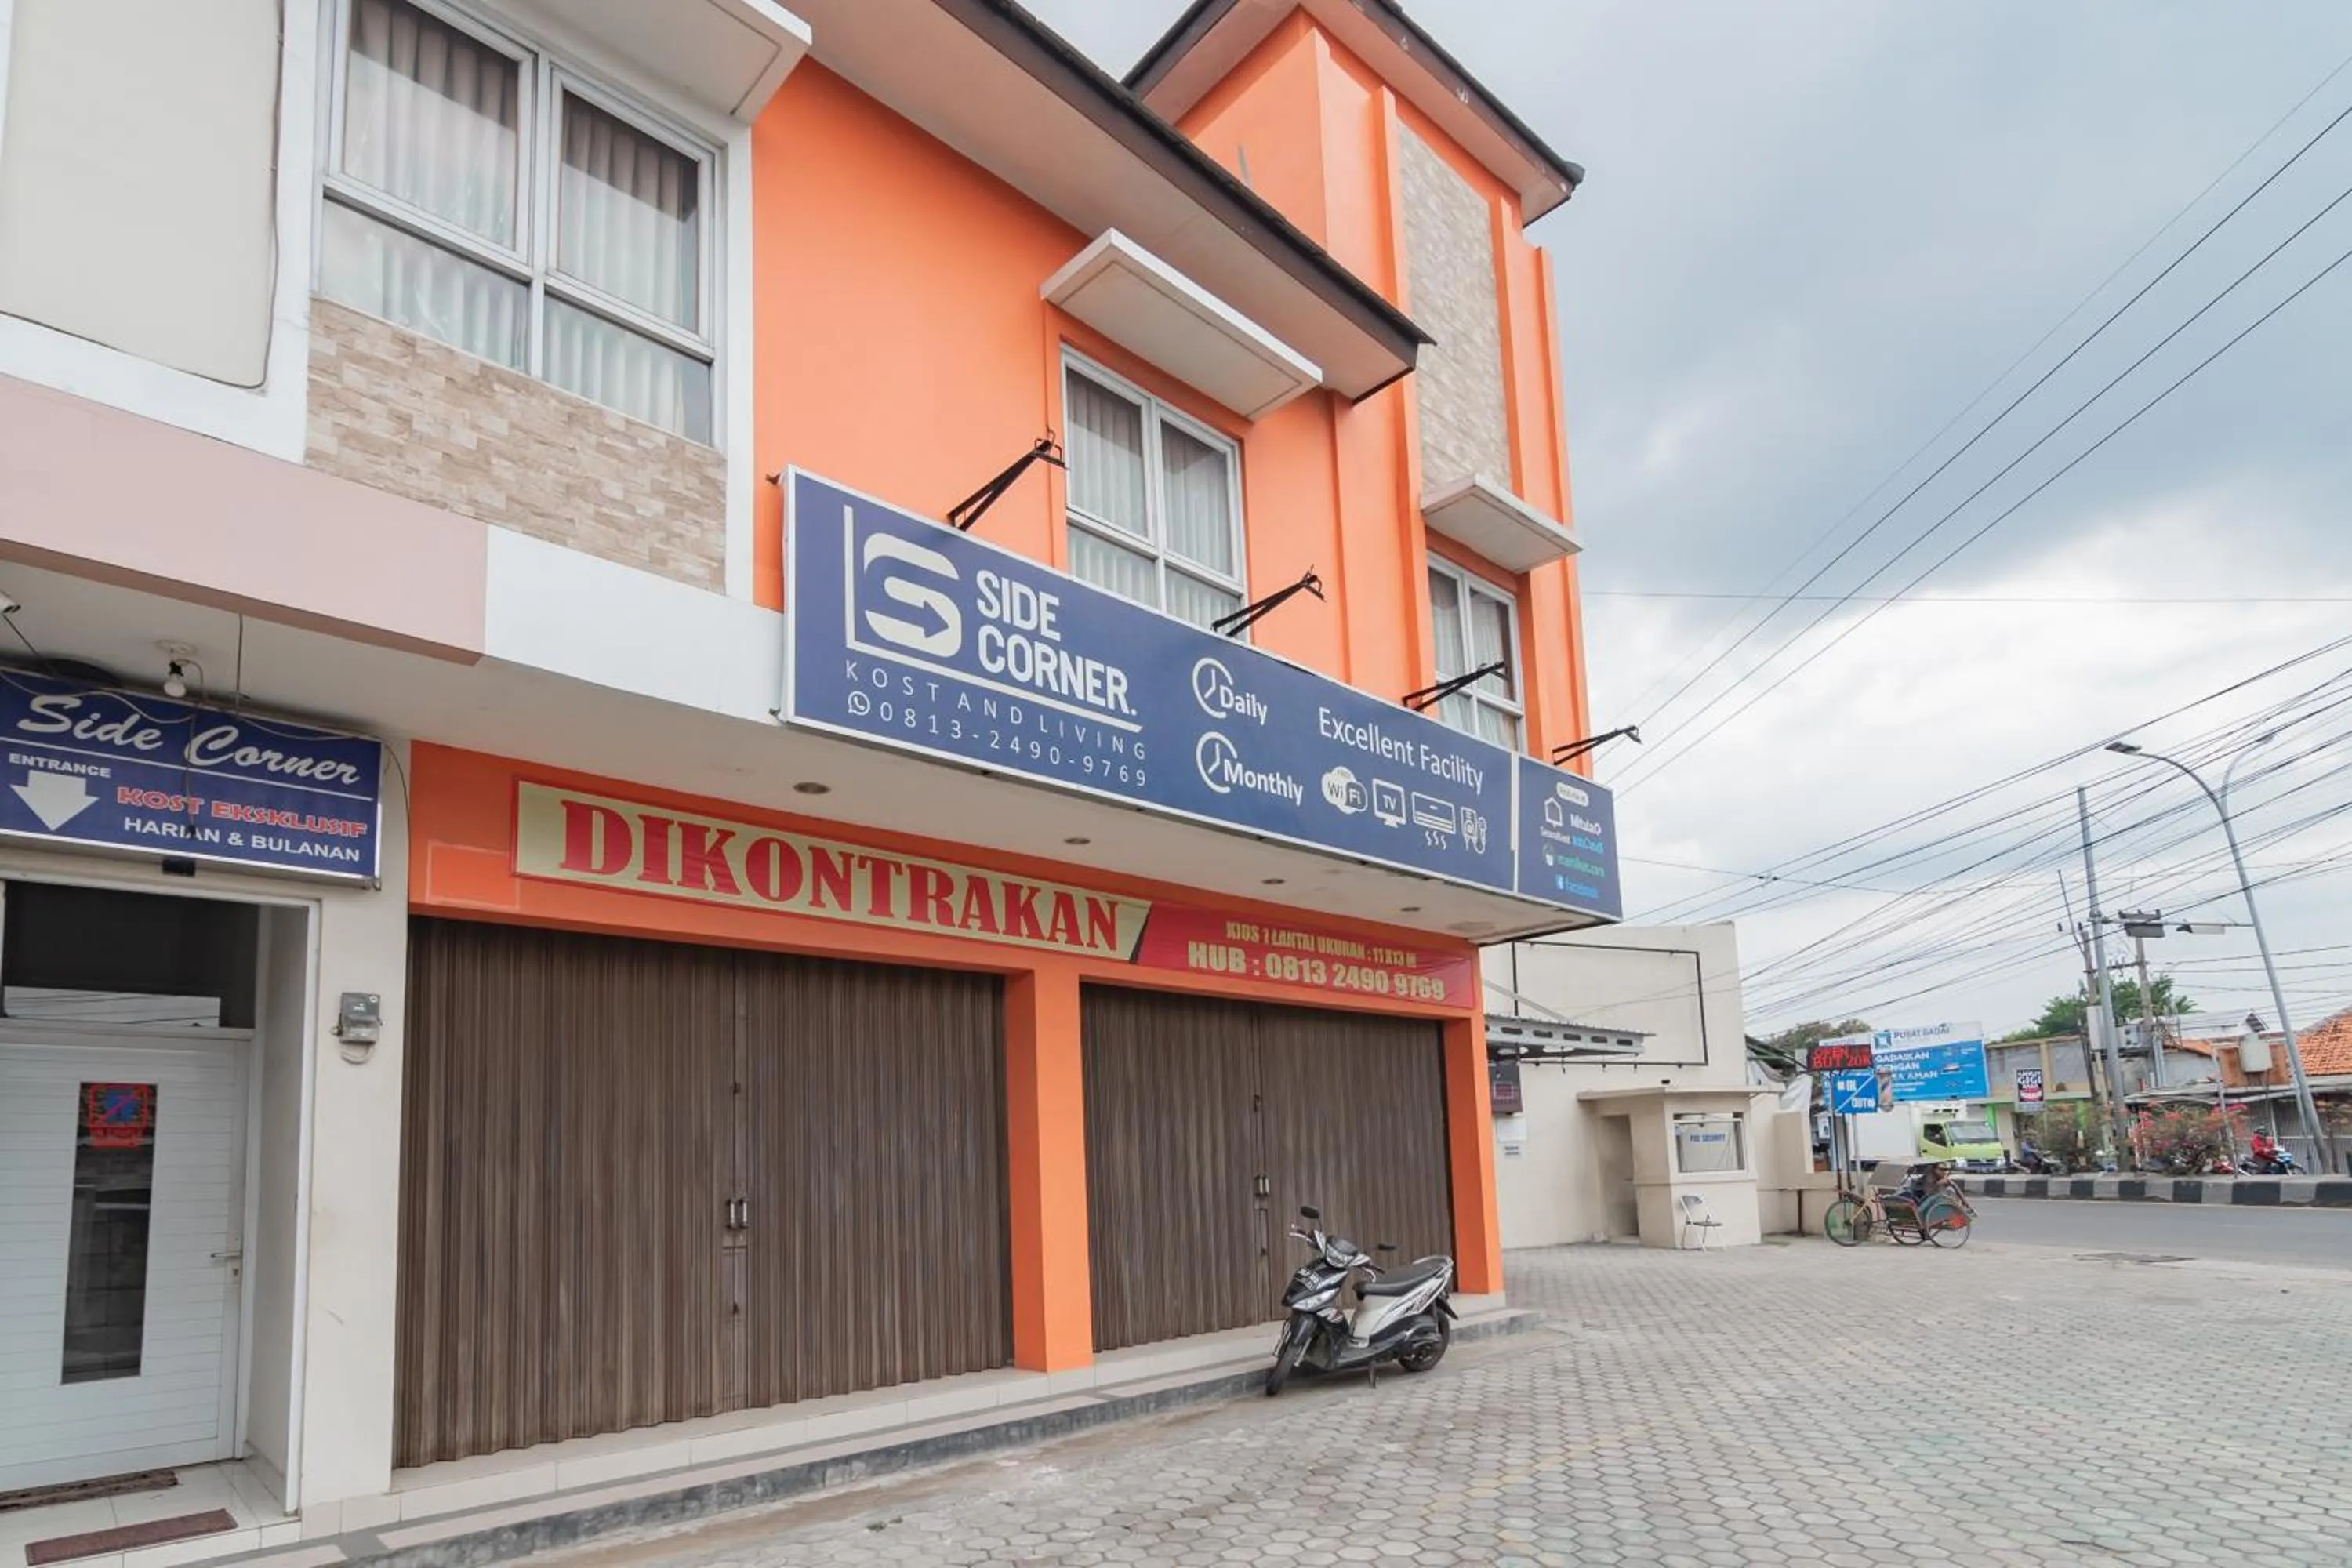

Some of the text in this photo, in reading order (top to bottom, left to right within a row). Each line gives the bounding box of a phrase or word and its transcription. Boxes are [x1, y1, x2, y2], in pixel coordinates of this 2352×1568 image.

[976, 569, 1062, 642] SIDE
[846, 659, 1145, 760] KOST AND LIVING
[1219, 684, 1268, 726] Daily
[17, 695, 360, 785] Side Corner
[880, 702, 1146, 786] 0813-2490-9769
[1319, 706, 1483, 796] Excellent Facility
[9, 753, 111, 779] ENTRANCE
[1224, 759, 1303, 807] Monthly
[116, 786, 368, 838] KOST EKSKLUSIF
[1382, 794, 1397, 811] TV
[124, 816, 360, 862] HARIAN & BULANAN
[559, 799, 1118, 952] DIKONTRAKAN
[1226, 921, 1260, 942] KIOS
[1272, 929, 1316, 951] LANTAI
[1317, 935, 1365, 960] UKURAN
[1265, 953, 1326, 985] 0813
[1332, 966, 1388, 993] 2490
[1393, 973, 1445, 1001] 9769
